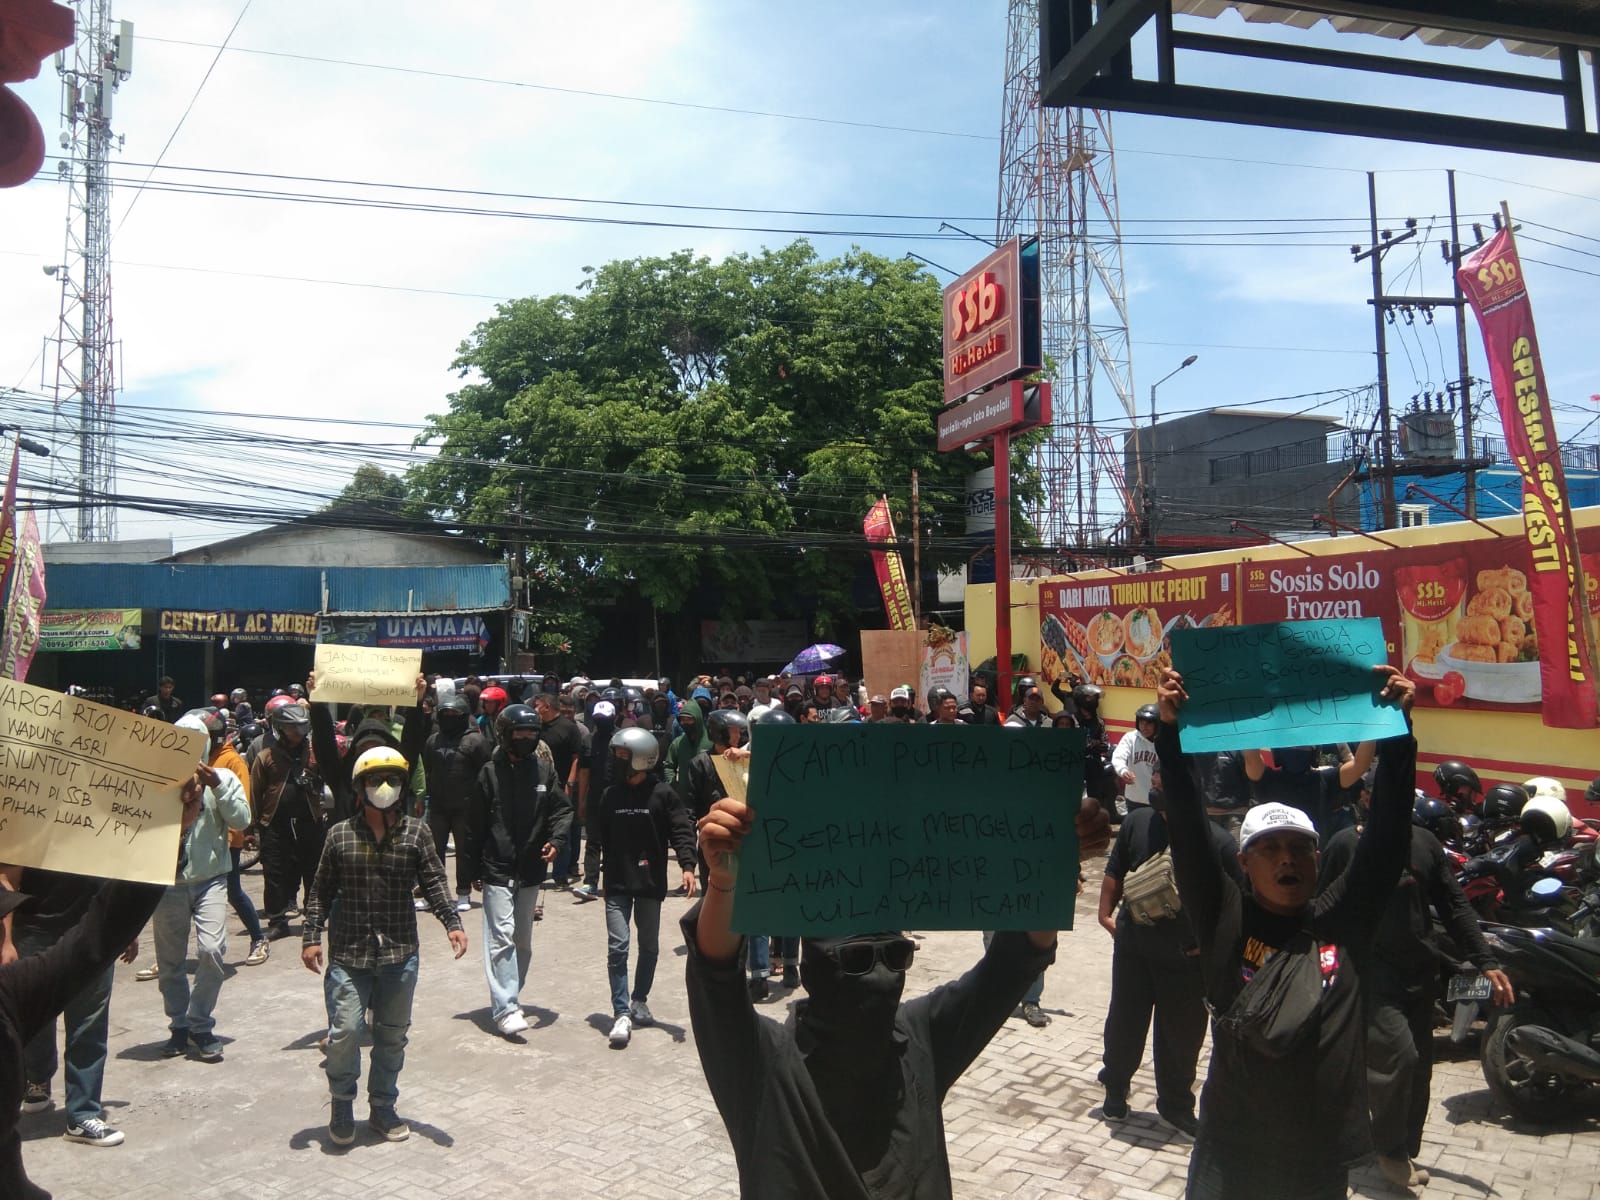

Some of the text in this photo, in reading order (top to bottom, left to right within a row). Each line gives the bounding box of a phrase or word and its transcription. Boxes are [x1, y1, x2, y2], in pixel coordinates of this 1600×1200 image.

[1478, 258, 1516, 291] SSb
[952, 271, 1001, 341] SSb
[1512, 336, 1547, 456] SPESIAL
[1059, 576, 1207, 608] DARI MATA TURUN KE PERUT
[1270, 561, 1380, 593] Sosis Solo
[1417, 581, 1445, 599] SSb
[161, 610, 239, 633] CENTRAL
[245, 613, 268, 633] AC
[271, 613, 318, 635] MOBIL
[1285, 595, 1362, 619] Frozen
[387, 618, 456, 637] UTAMA
[512, 618, 524, 634] AC
[1277, 625, 1351, 650] PEMDA
[8, 717, 108, 757] WADUNG ASRI
[893, 739, 989, 781] PUTRA
[89, 770, 145, 800] LAHAN
[3, 797, 48, 819] PIHAK
[49, 785, 59, 801] DI
[63, 786, 92, 806] SSB
[112, 803, 152, 819] BUKAN
[762, 815, 905, 868] BERHAK
[746, 863, 864, 895] LAHAN
